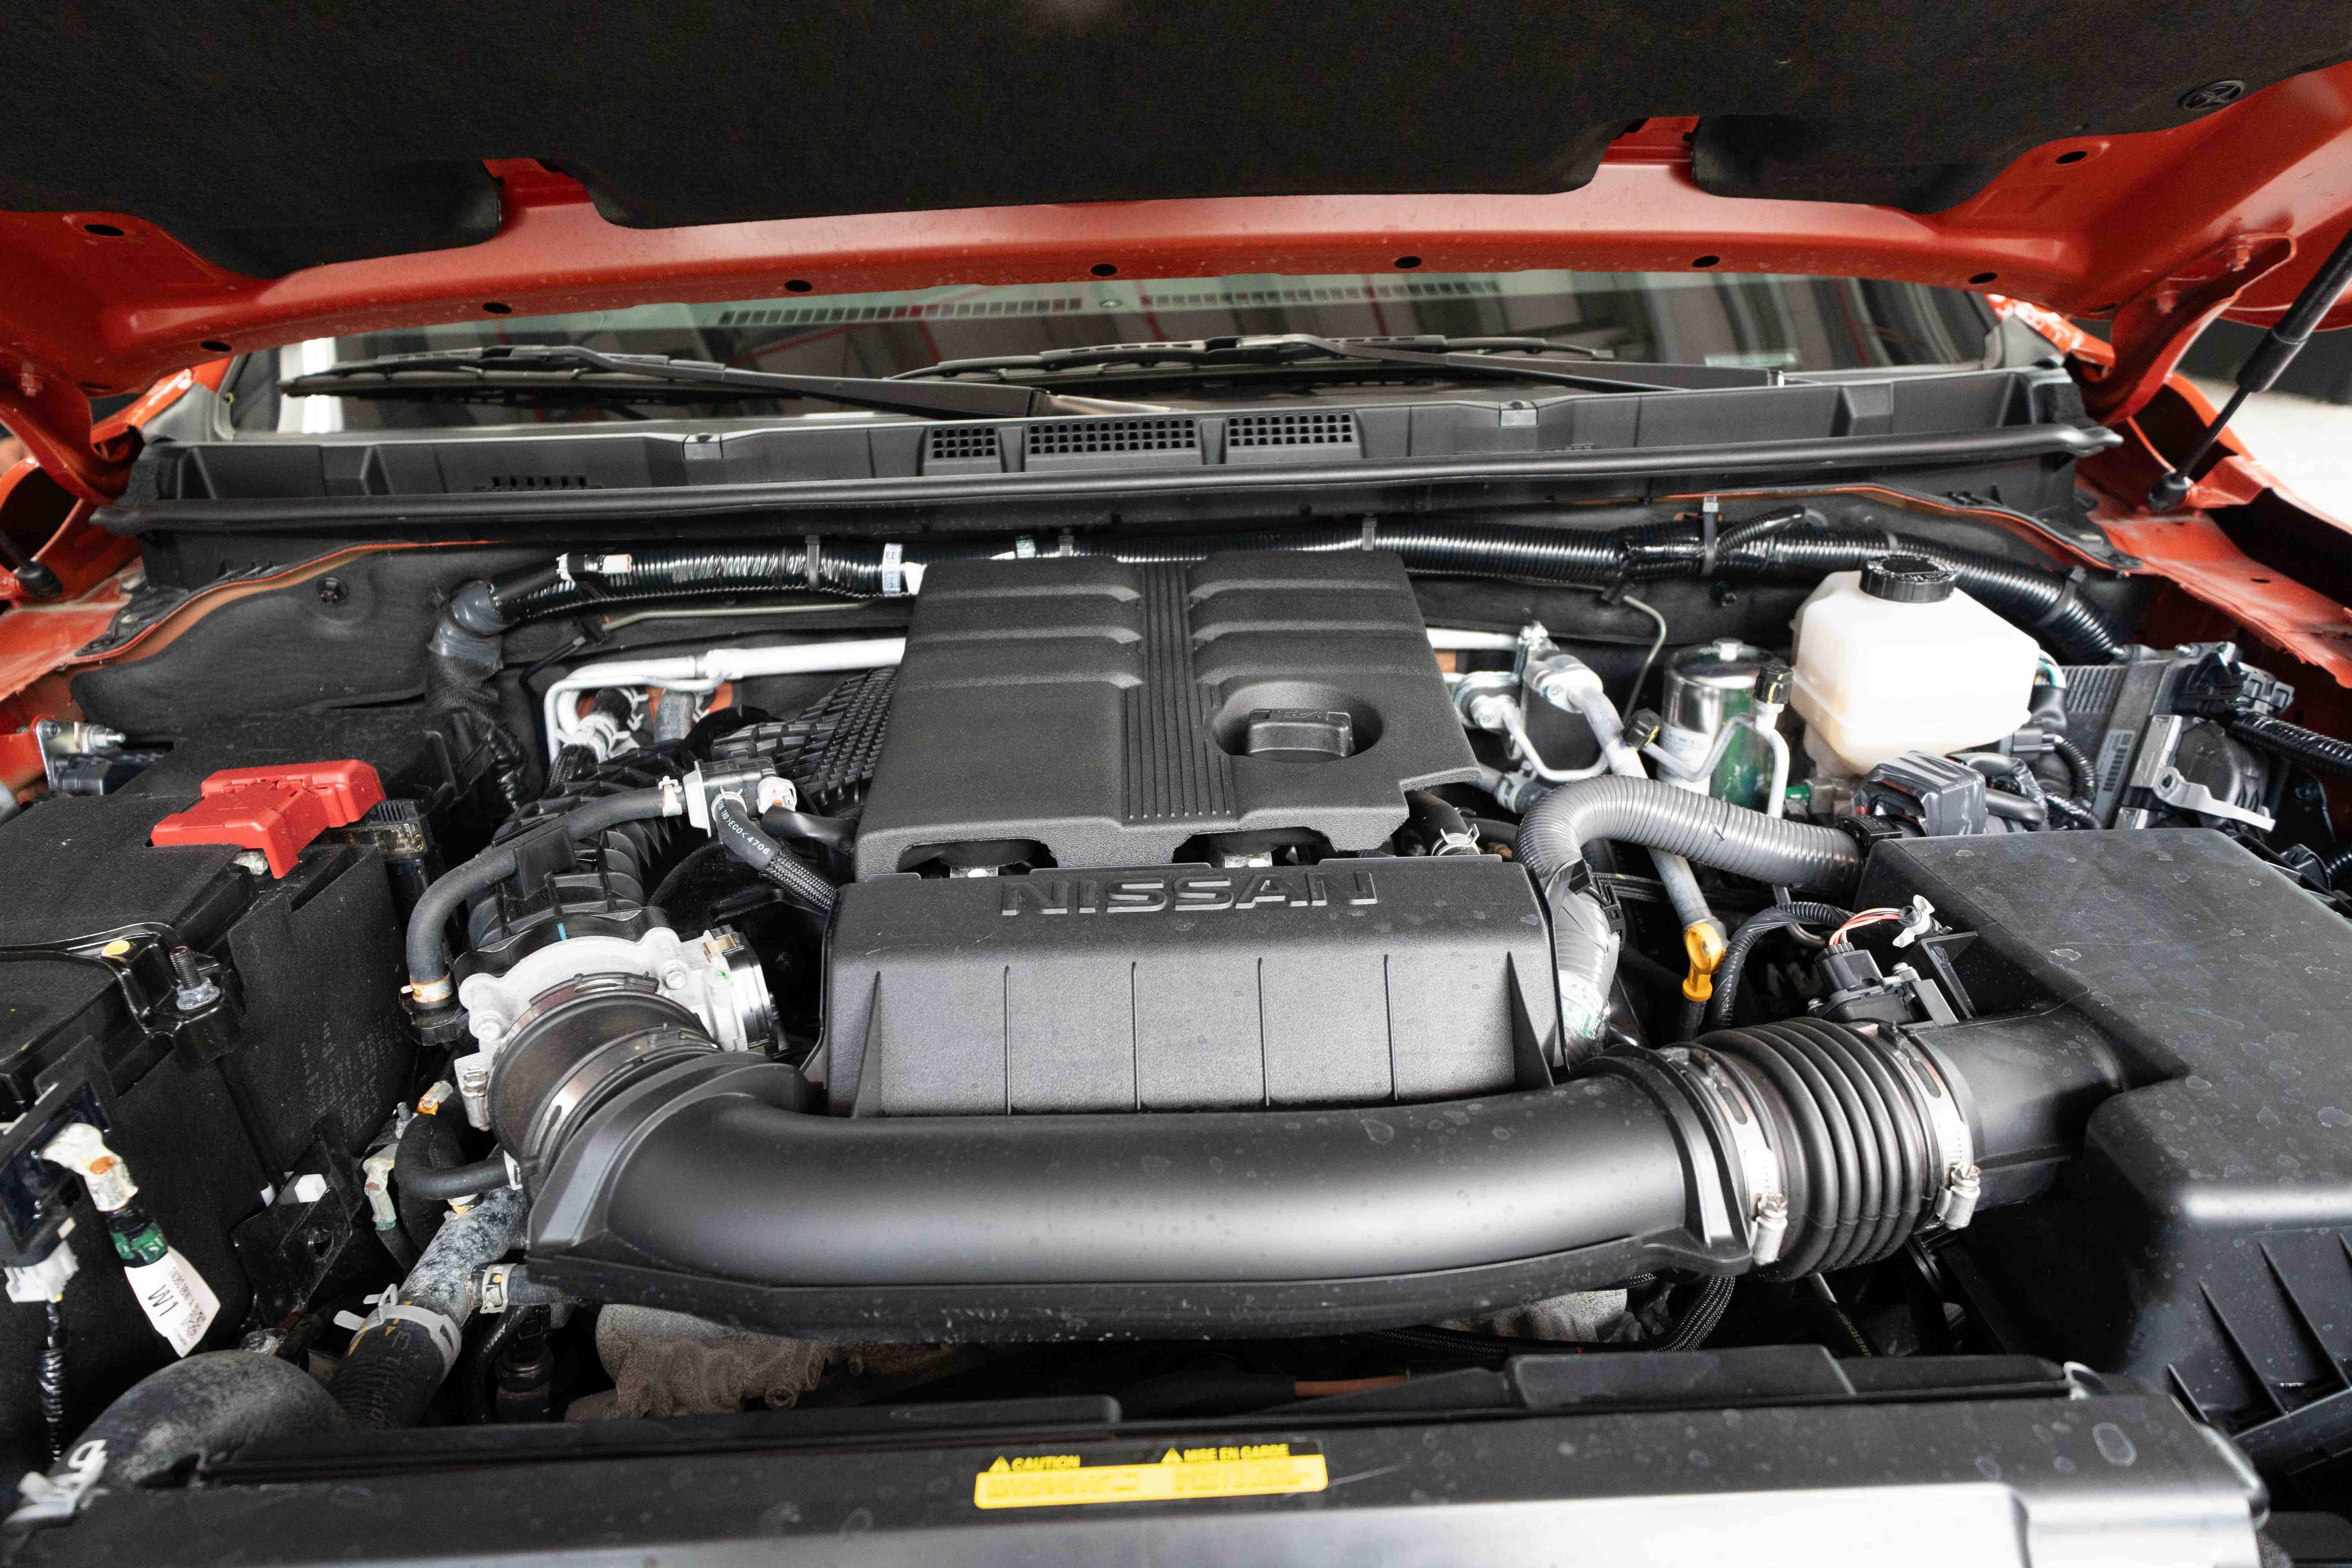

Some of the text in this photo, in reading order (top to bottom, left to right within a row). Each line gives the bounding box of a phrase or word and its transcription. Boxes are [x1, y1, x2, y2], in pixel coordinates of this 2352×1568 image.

[747, 837, 771, 854] 4706
[1001, 871, 1378, 916] NISSAN
[1011, 1455, 1080, 1471] CAUTION
